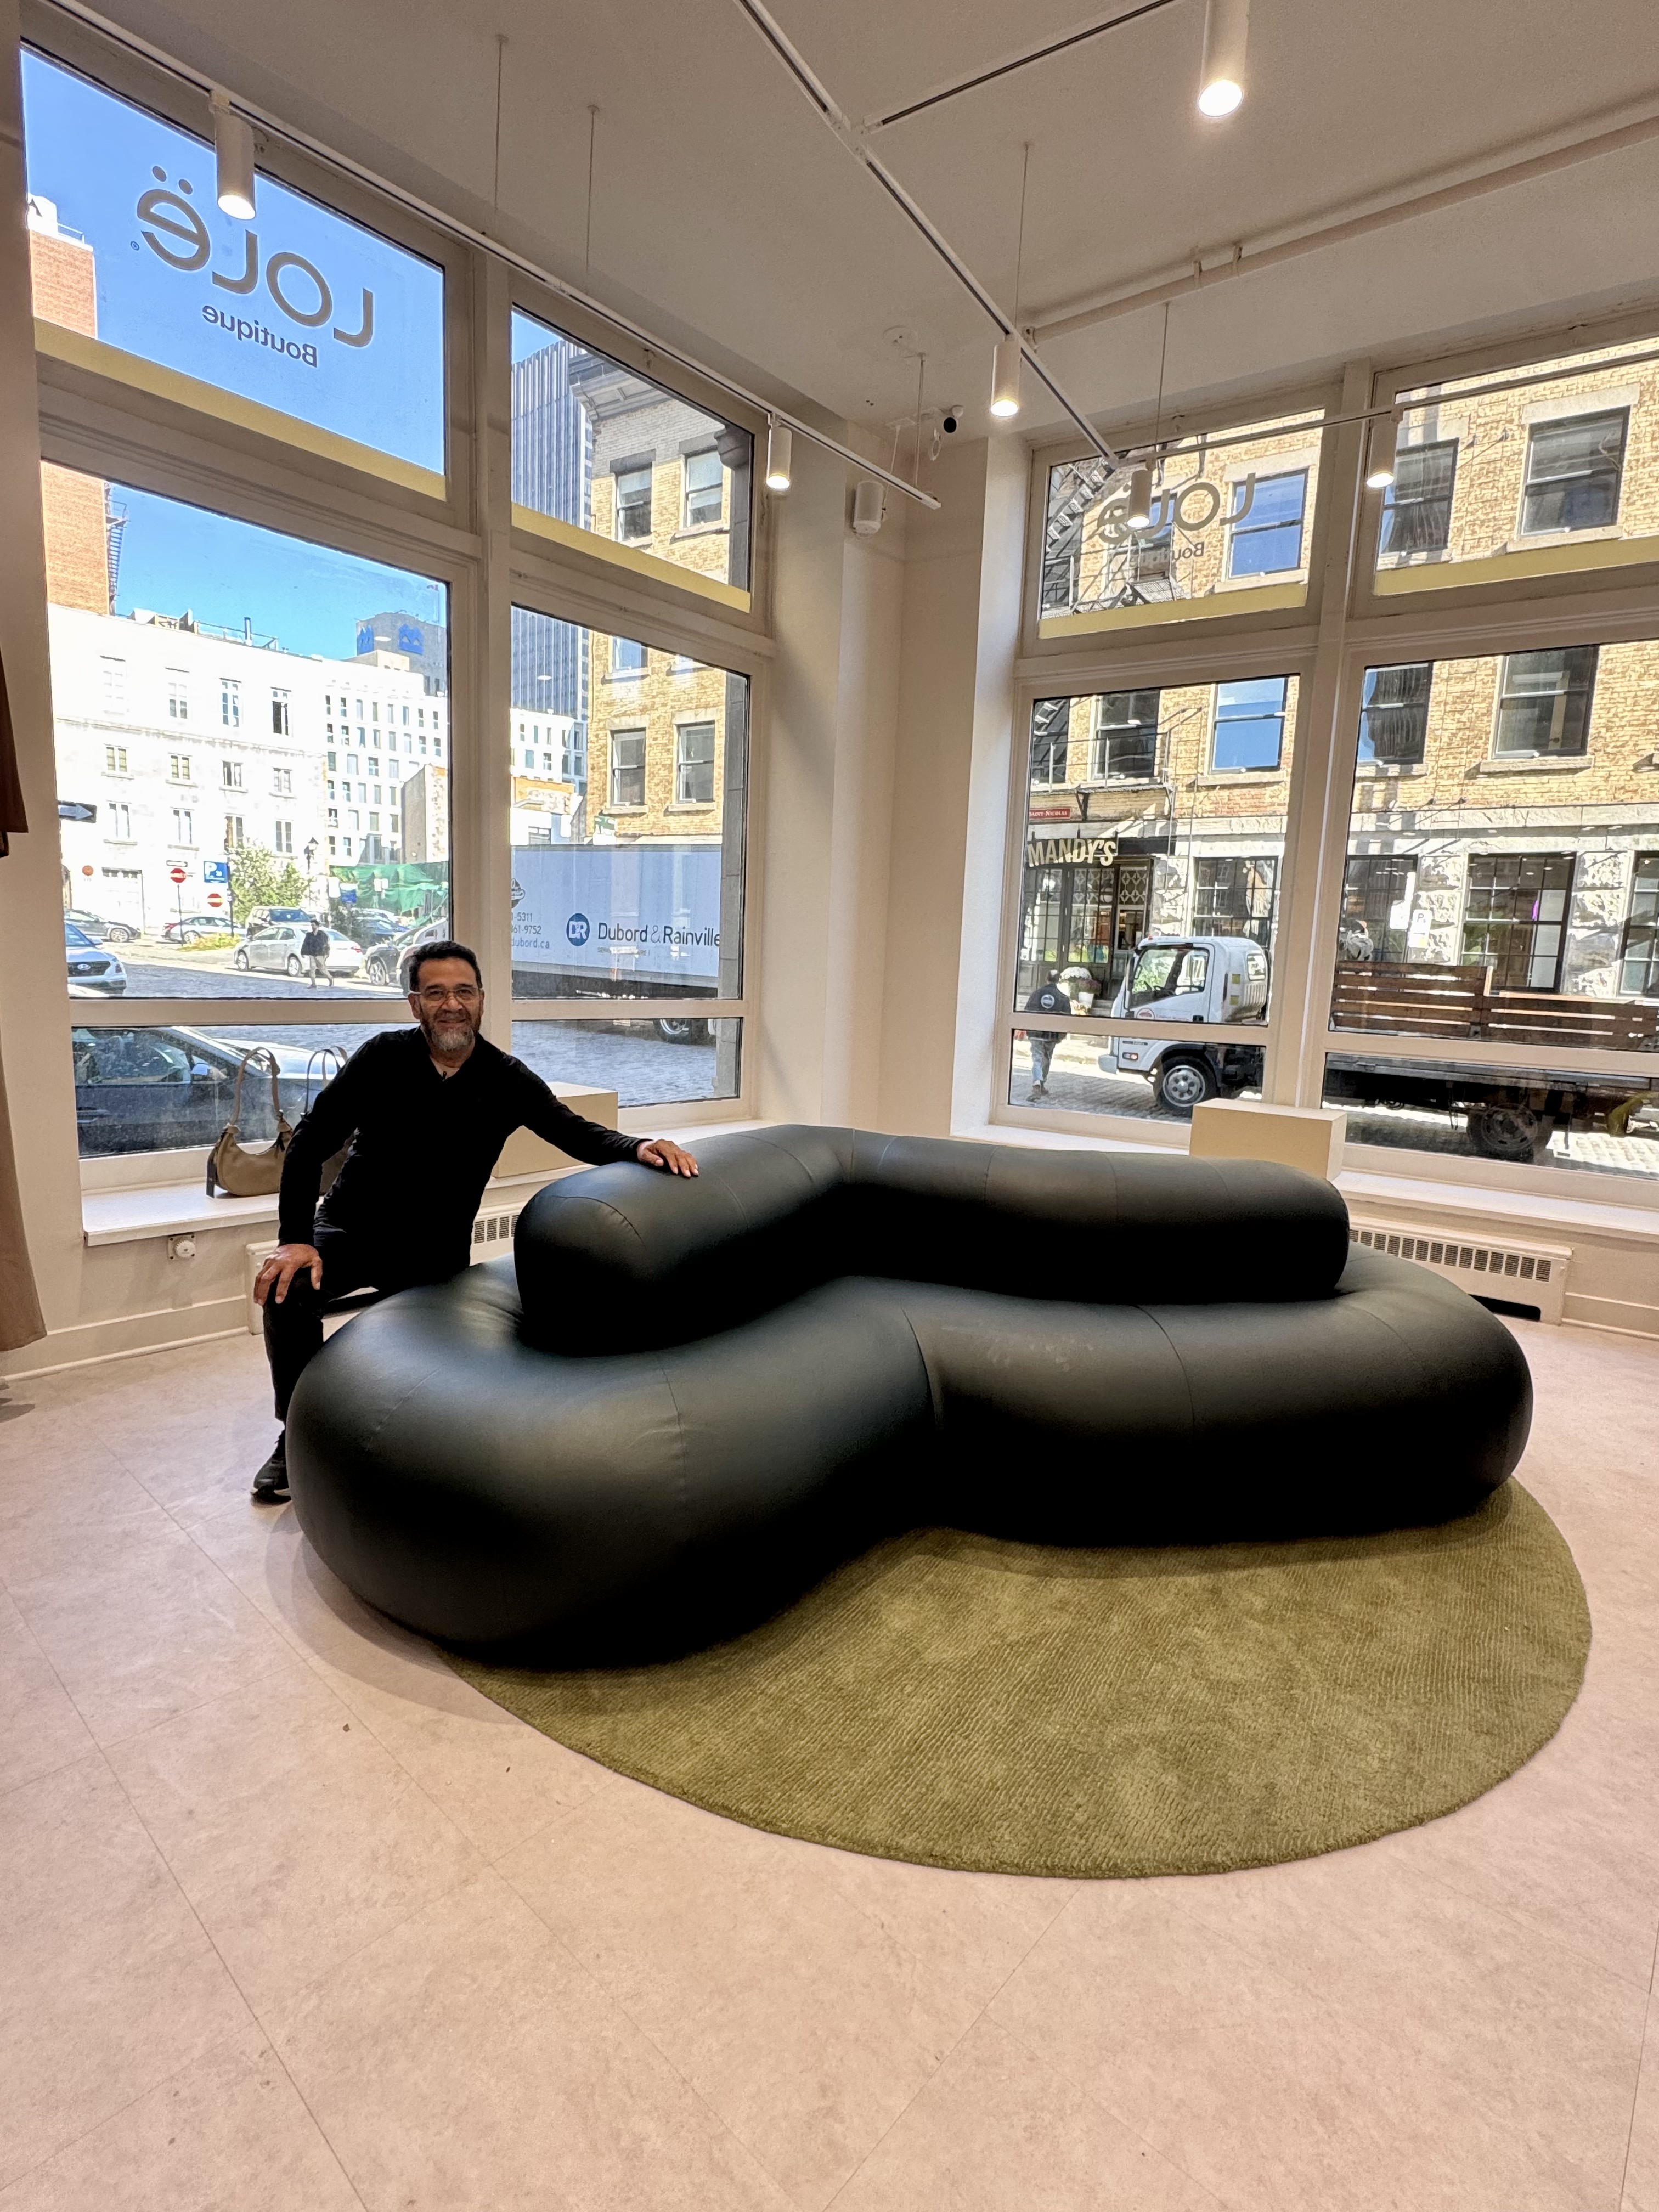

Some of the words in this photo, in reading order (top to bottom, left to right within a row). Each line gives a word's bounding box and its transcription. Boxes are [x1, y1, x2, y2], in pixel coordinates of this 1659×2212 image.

[1027, 839, 1116, 867] MANDY'S
[597, 922, 648, 943] Dubord
[650, 925, 661, 944] &
[663, 926, 720, 947] Rainville
